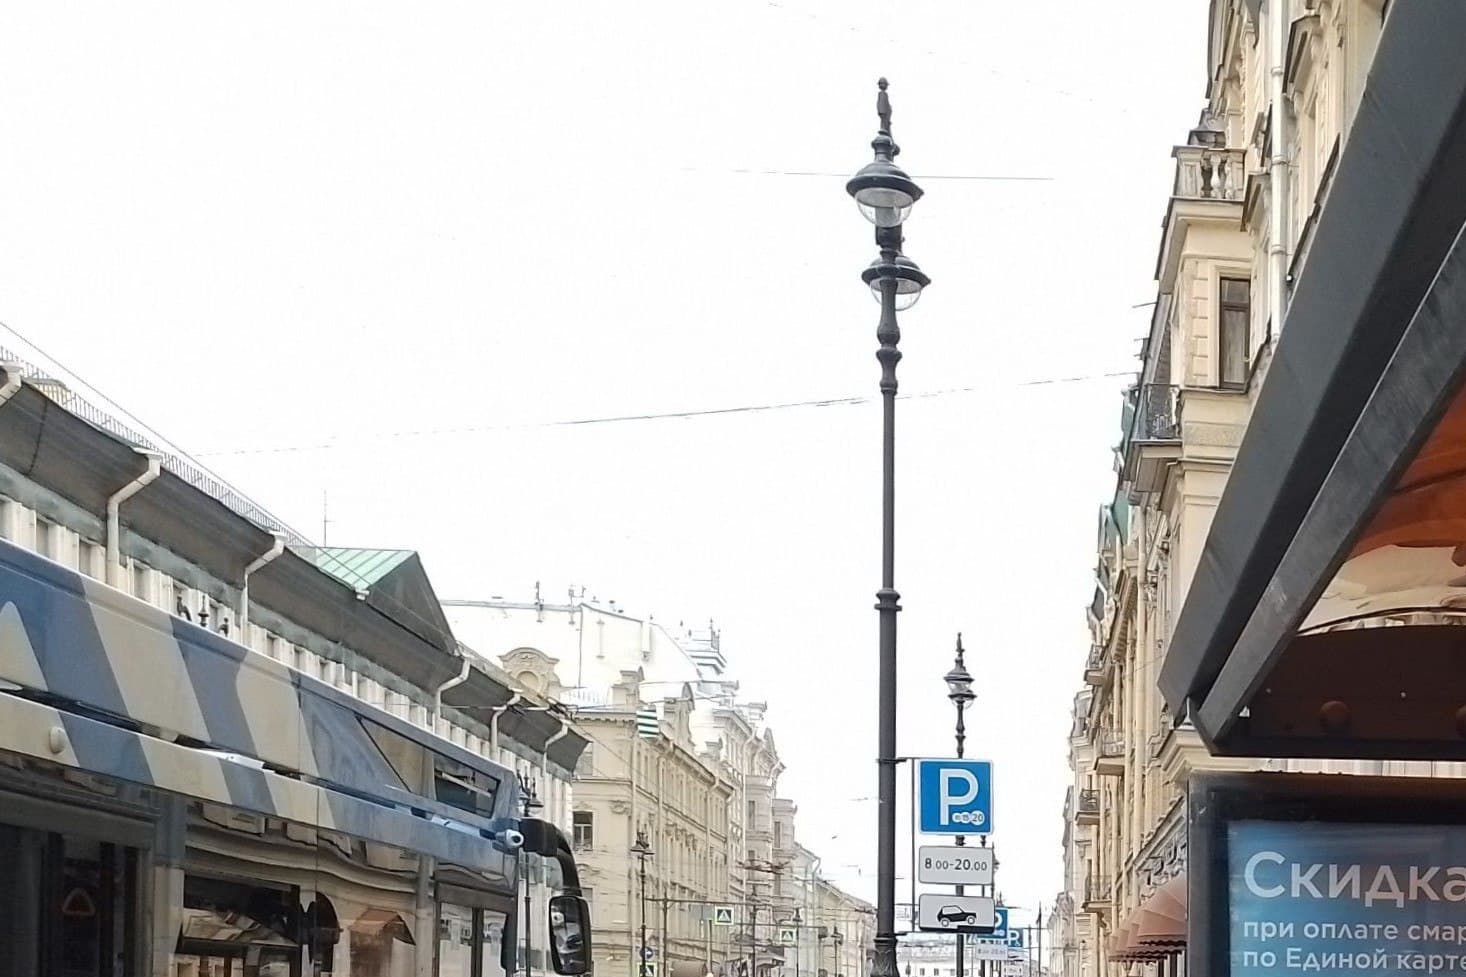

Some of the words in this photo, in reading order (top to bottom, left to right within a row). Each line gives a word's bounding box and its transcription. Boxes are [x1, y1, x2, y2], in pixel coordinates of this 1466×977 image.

[940, 768, 978, 825] P
[925, 857, 988, 871] 800-20.00
[1243, 922, 1294, 942] при
[1304, 923, 1398, 941] оплате
[1243, 951, 1276, 969] по
[1286, 947, 1387, 973] Единой
